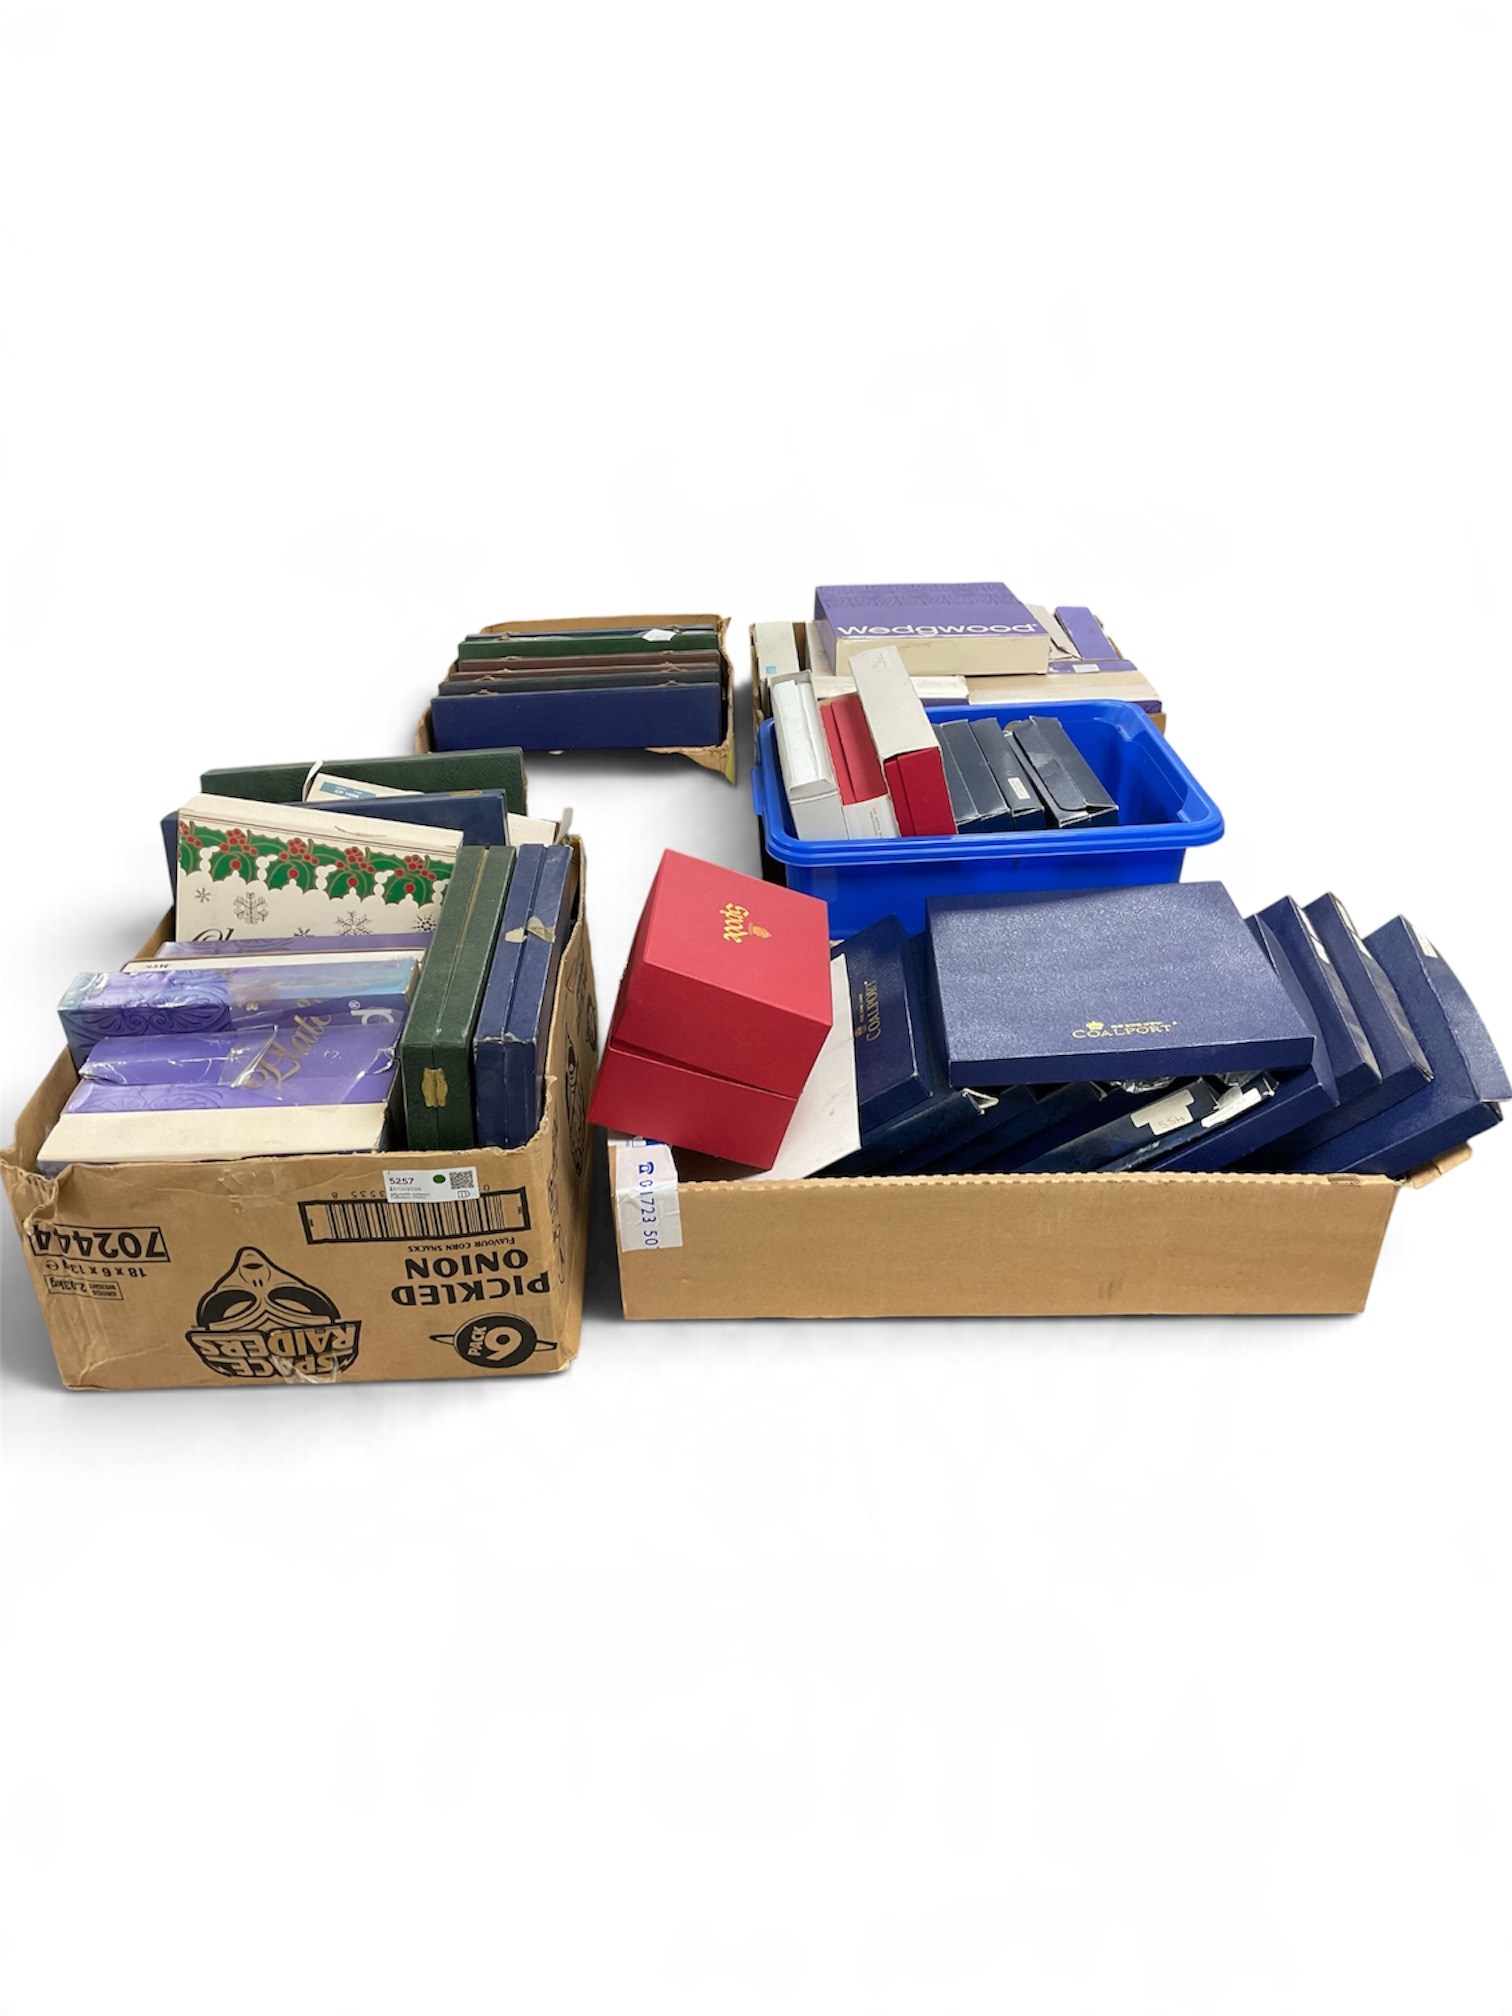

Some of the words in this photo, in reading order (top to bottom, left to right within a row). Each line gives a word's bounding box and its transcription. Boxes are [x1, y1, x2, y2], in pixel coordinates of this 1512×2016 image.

[720, 903, 749, 943] Spode
[865, 980, 881, 1041] COALPORT
[1072, 1024, 1171, 1039] COALPORT
[389, 1177, 414, 1185] 5257
[639, 1179, 657, 1223] 01723
[32, 1225, 168, 1259] 702444
[408, 1244, 443, 1252] SNACKS
[445, 1242, 471, 1251] CORN
[475, 1237, 516, 1248] FLAVOUR
[643, 1230, 660, 1249] 50
[128, 1267, 148, 1278] 18
[404, 1249, 528, 1280] ONION
[391, 1271, 550, 1306] PICKLED
[191, 1325, 356, 1357] RAIDERS
[467, 1325, 489, 1357] PACK
